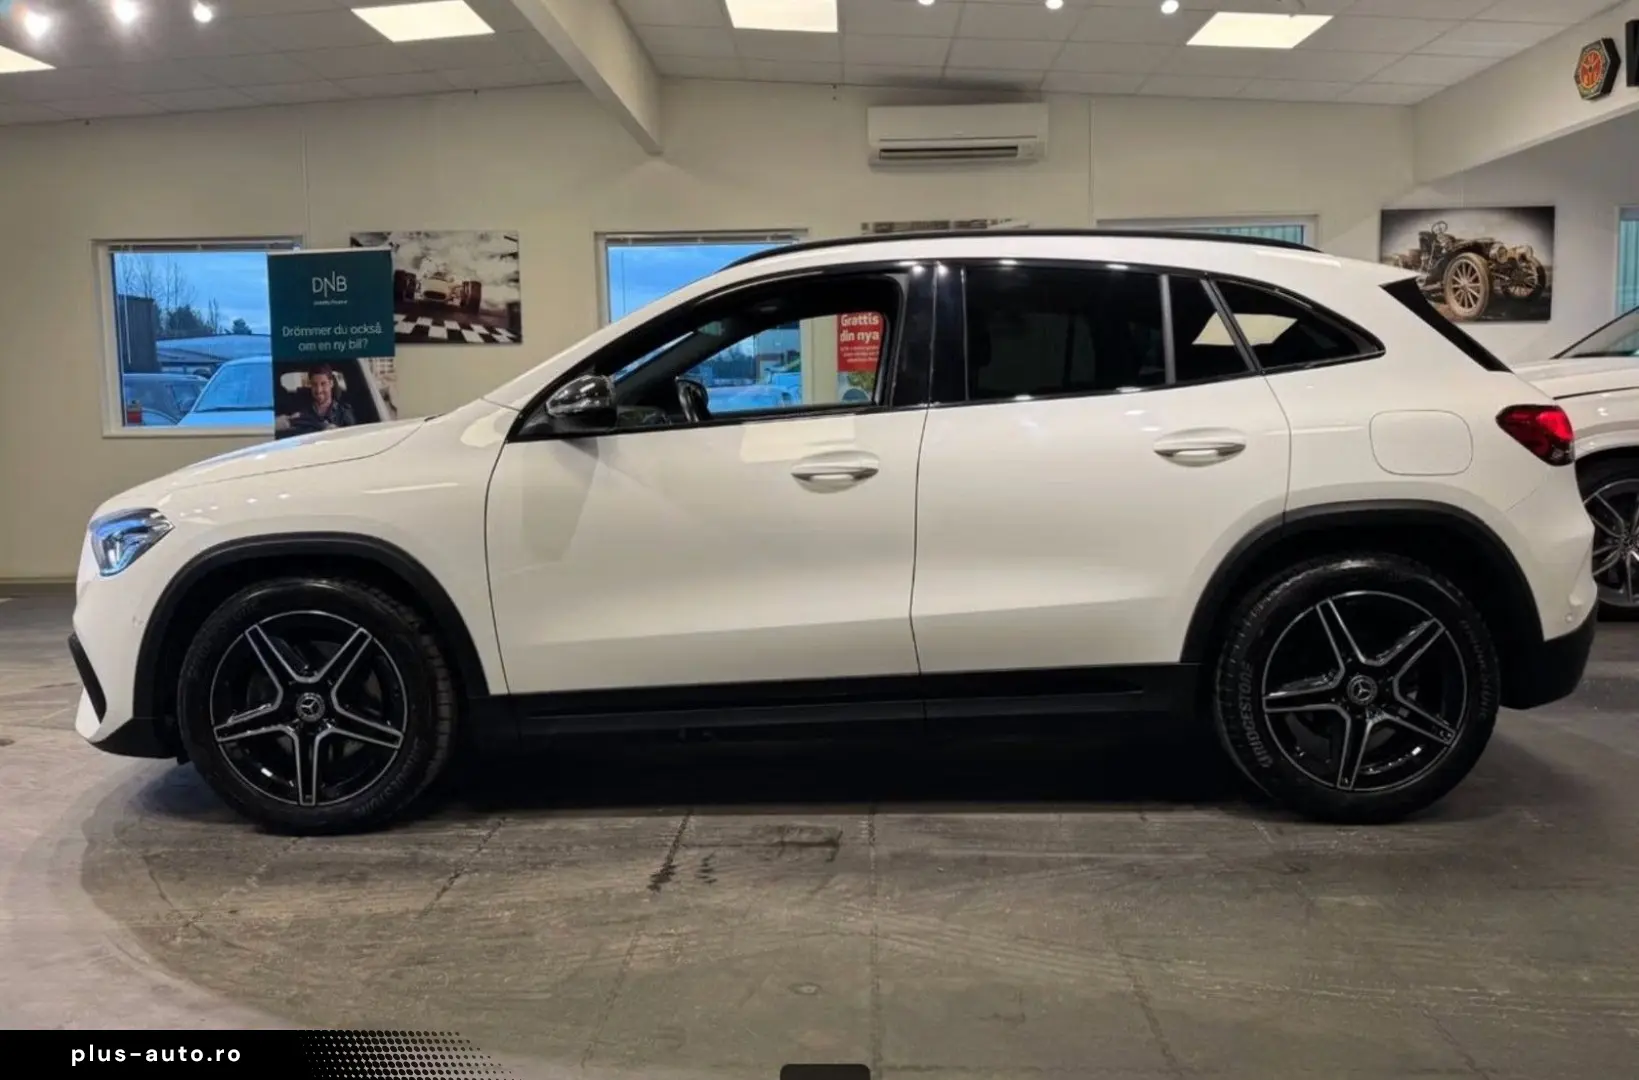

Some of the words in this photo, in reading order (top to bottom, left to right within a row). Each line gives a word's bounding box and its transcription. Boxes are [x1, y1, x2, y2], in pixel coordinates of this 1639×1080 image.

[312, 271, 348, 297] DNB
[841, 312, 880, 326] Grattis
[282, 325, 332, 337] Drömmer
[334, 323, 348, 335] du
[350, 321, 382, 335] också
[840, 330, 855, 342] din
[857, 331, 880, 343] nya
[298, 342, 316, 351] om
[318, 341, 331, 351] en
[333, 340, 347, 352] ny
